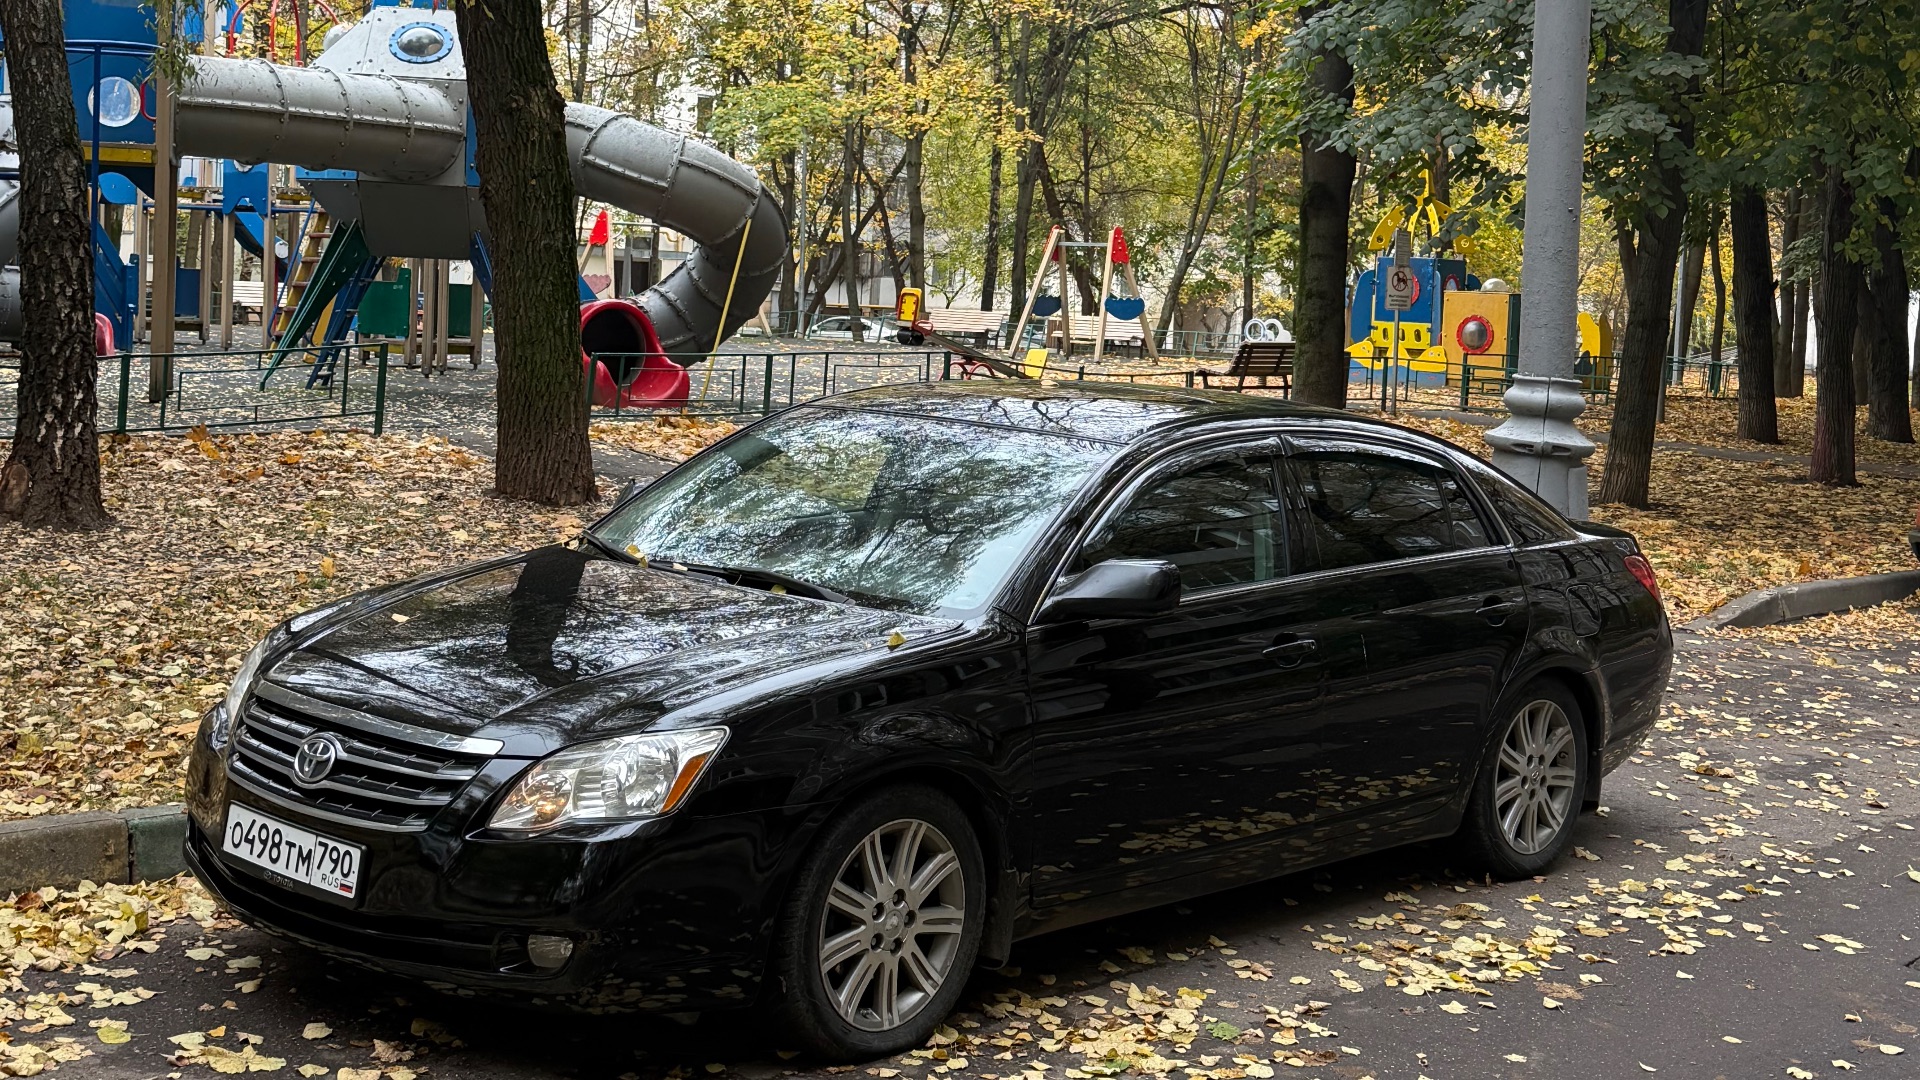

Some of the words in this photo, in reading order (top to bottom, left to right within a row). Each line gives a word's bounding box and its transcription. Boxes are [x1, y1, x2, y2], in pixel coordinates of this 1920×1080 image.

[317, 841, 353, 878] 790
[272, 874, 294, 888] TOYOTA
[321, 874, 339, 889] RUS
